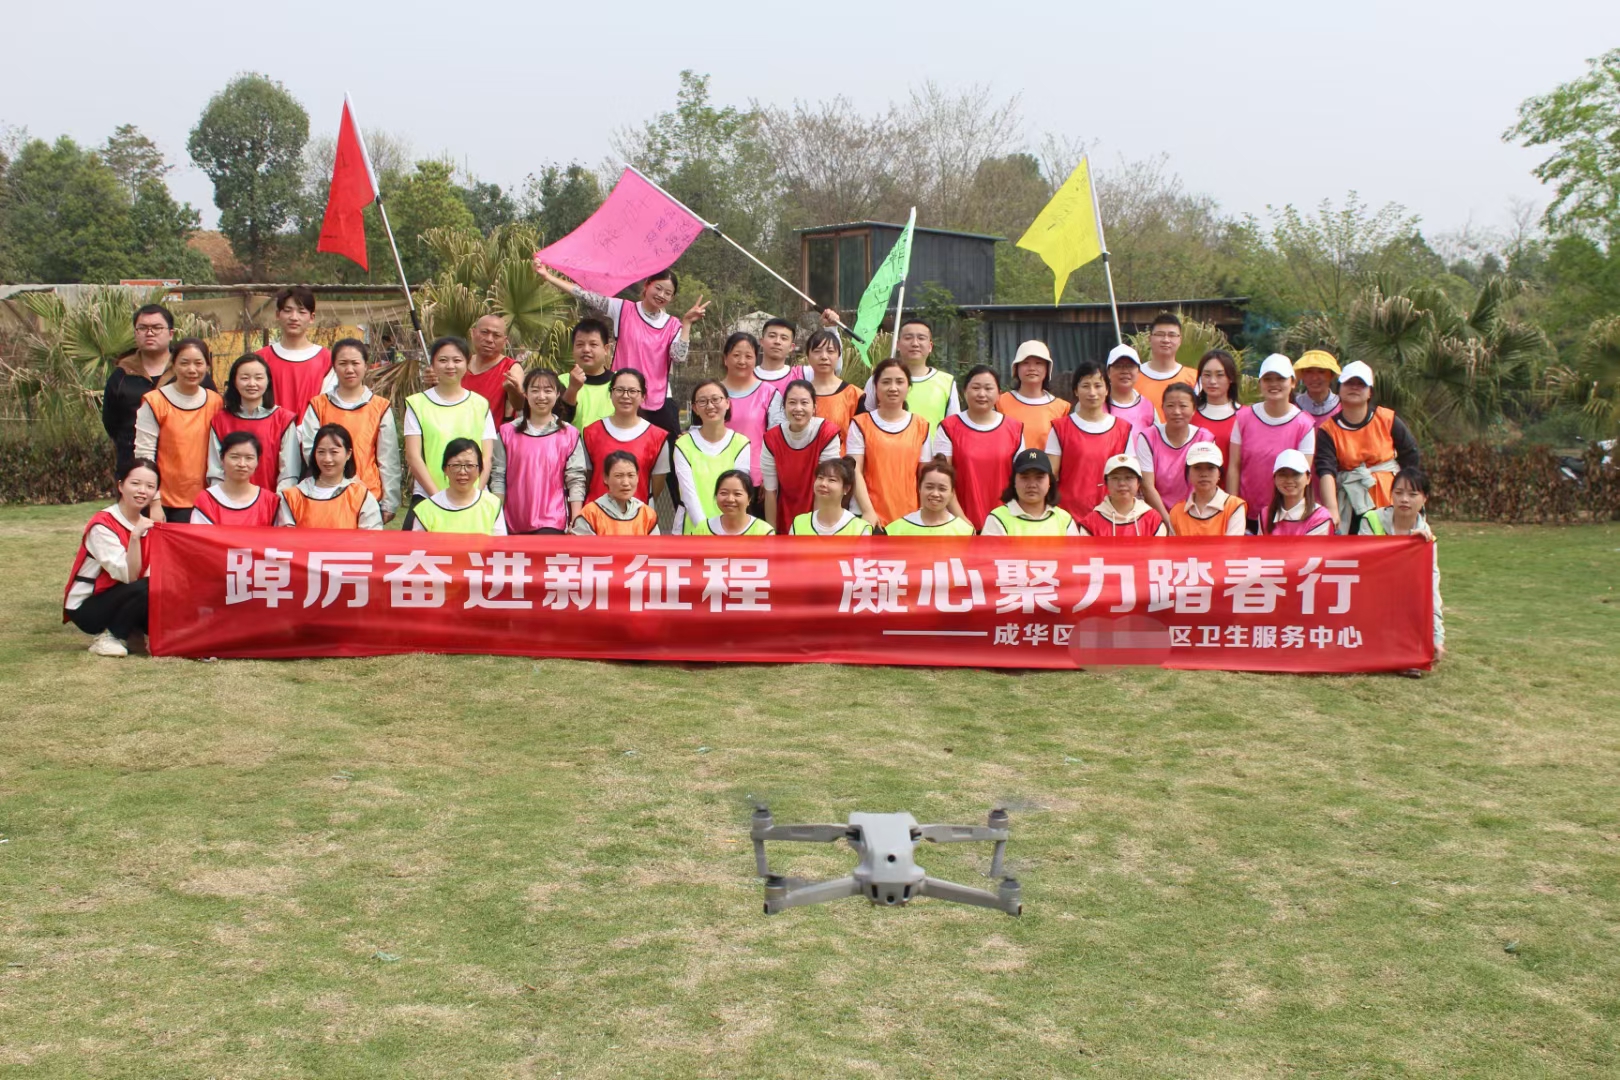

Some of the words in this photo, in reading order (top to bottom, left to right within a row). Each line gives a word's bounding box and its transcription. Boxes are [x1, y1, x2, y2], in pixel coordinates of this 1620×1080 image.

[225, 548, 772, 612] 踔厉奋进新征程
[838, 557, 1360, 615] 凝心聚力踏春行
